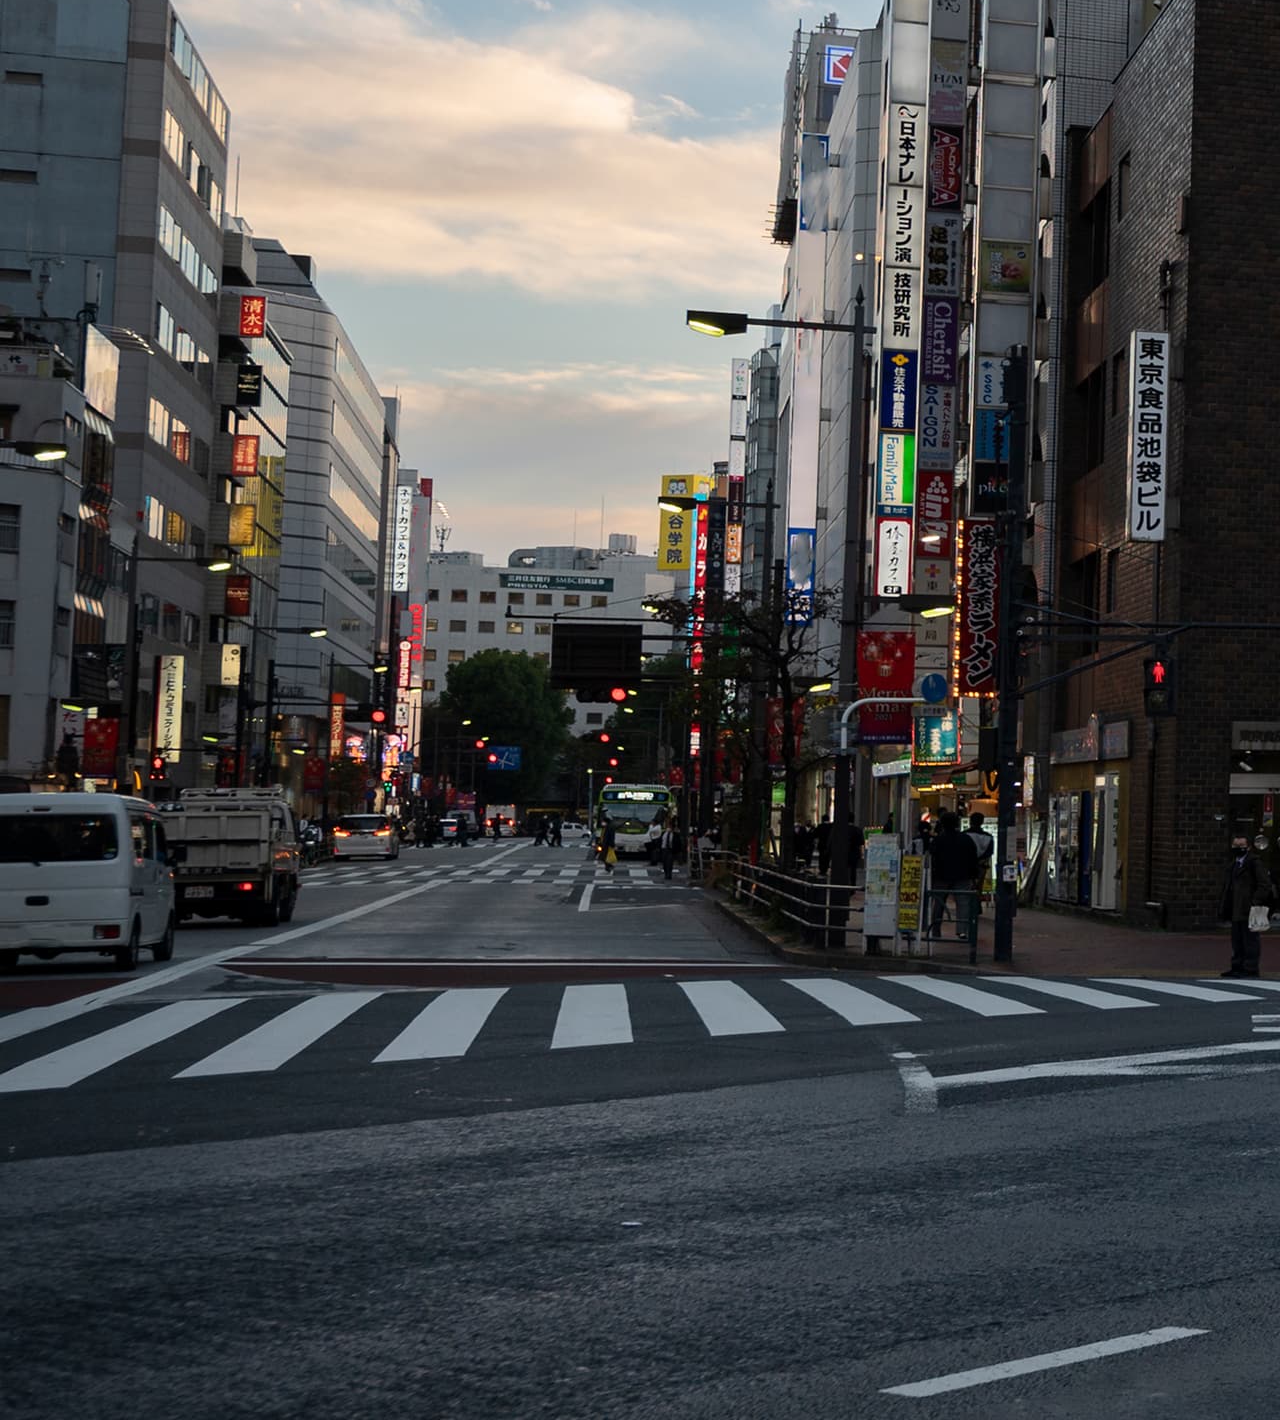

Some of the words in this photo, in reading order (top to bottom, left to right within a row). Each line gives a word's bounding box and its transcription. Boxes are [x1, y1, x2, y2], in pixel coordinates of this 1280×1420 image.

[243, 298, 264, 326] 清水
[933, 301, 952, 375] Cherish
[922, 383, 939, 448] SAIGON
[1136, 338, 1165, 531] 東京食品池袋ビル
[883, 436, 899, 502] FamilyMart
[396, 489, 409, 589] ネットカフェ&カラオケ
[961, 523, 998, 688] 横浜家系ラーメン
